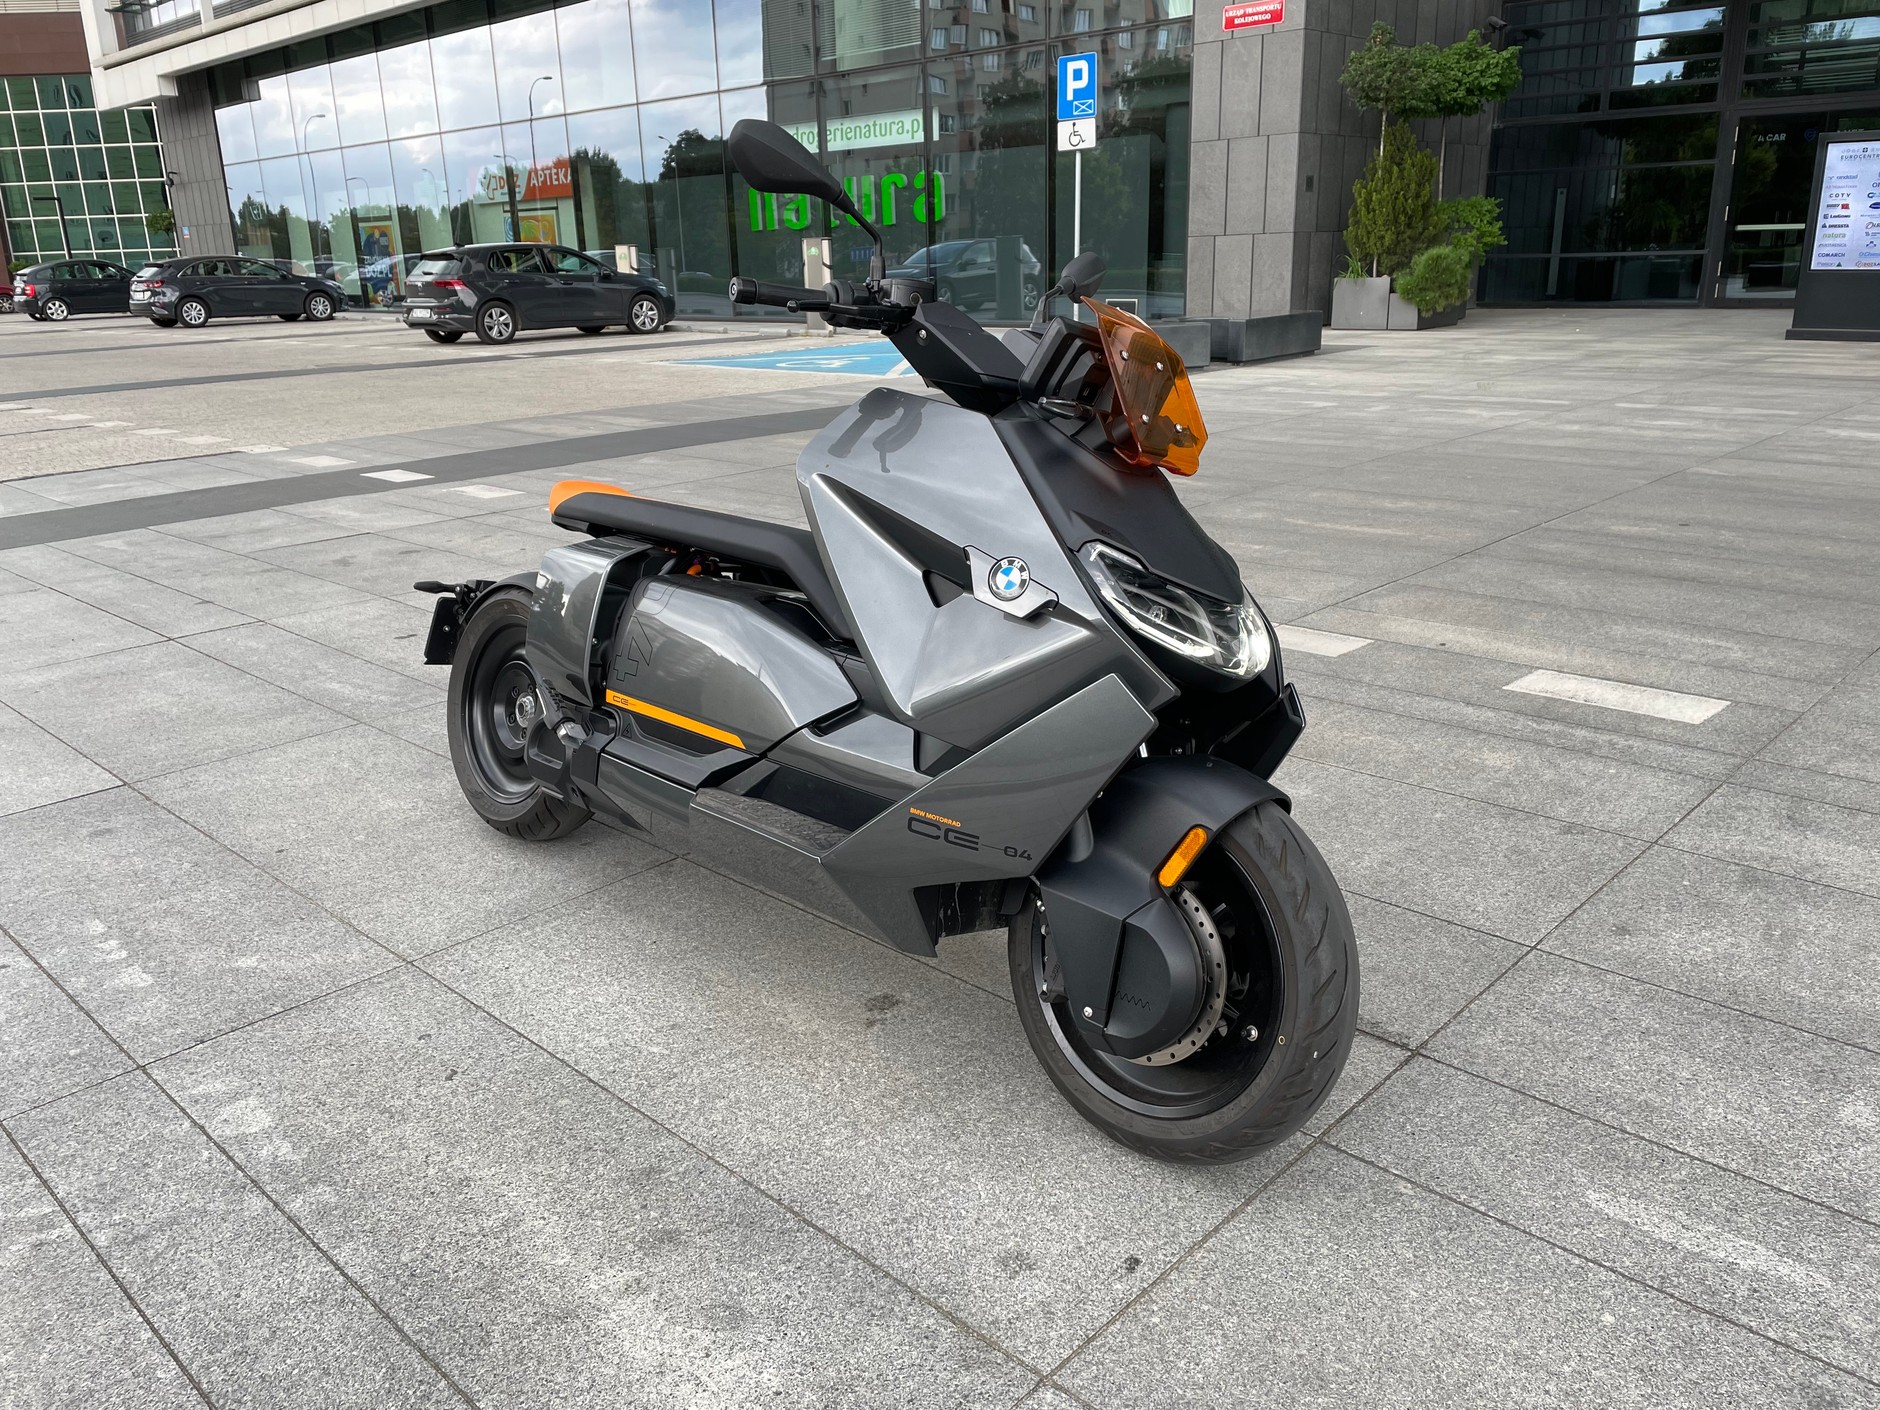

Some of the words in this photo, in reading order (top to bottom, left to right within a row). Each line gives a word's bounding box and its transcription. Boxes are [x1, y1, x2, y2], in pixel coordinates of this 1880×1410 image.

[1226, 9, 1244, 17] URZĄD
[1246, 3, 1282, 14] TRANSPORTU
[1234, 13, 1271, 24] KOLEJOWEGO
[1066, 59, 1089, 101] P
[793, 118, 924, 150] droerienatura.p
[1766, 133, 1786, 142] CAR
[748, 170, 946, 232] naura
[1000, 559, 1028, 580] BMW
[910, 807, 926, 817] BMW
[926, 812, 961, 827] MOTORRAD
